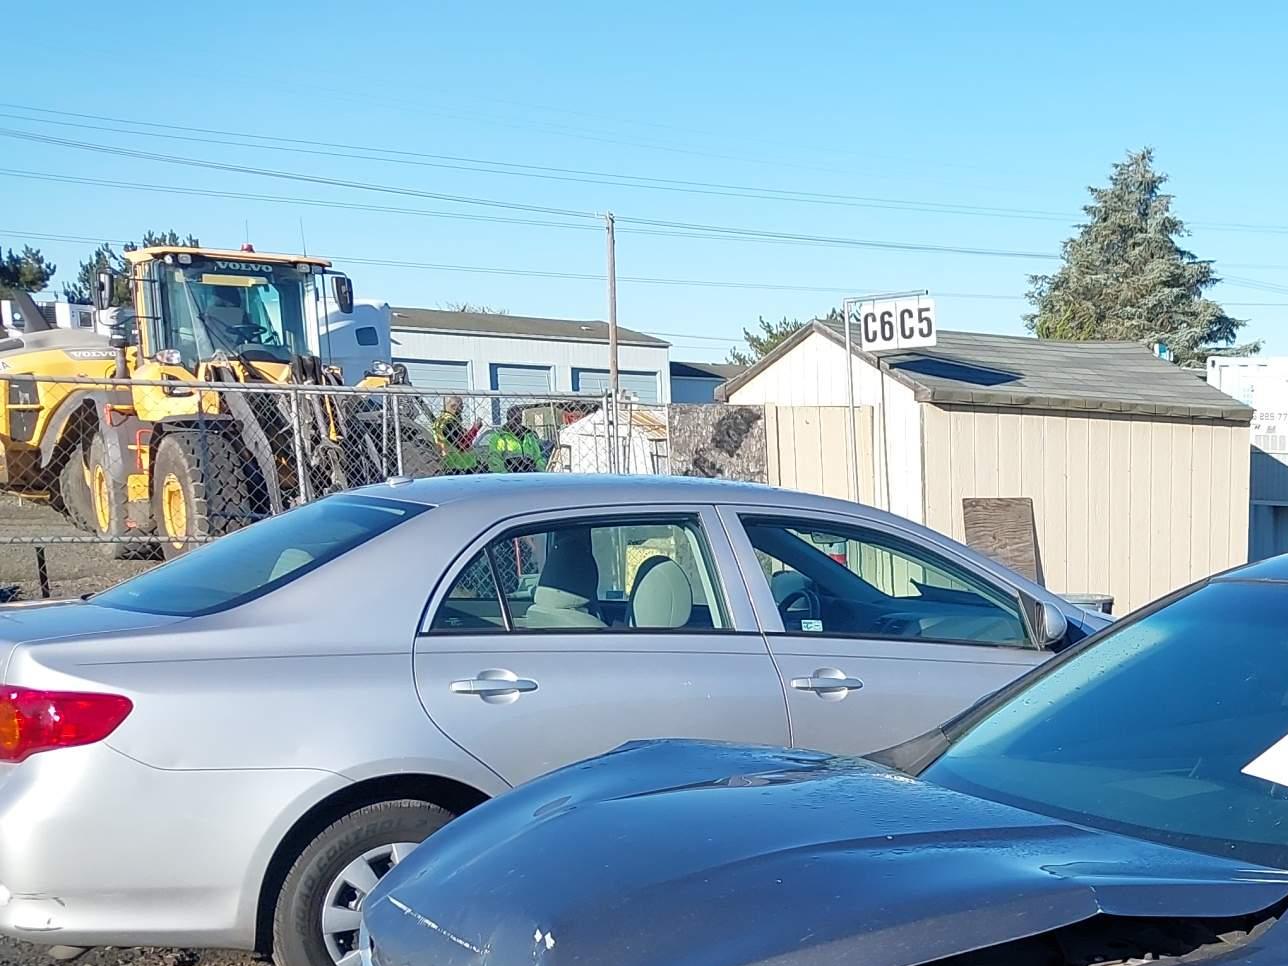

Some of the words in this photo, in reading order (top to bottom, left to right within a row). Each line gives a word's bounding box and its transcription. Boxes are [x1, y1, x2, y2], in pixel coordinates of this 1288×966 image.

[216, 261, 273, 273] VOLVO
[863, 311, 894, 343] C6
[900, 307, 932, 340] C5
[70, 350, 117, 358] VOLVO
